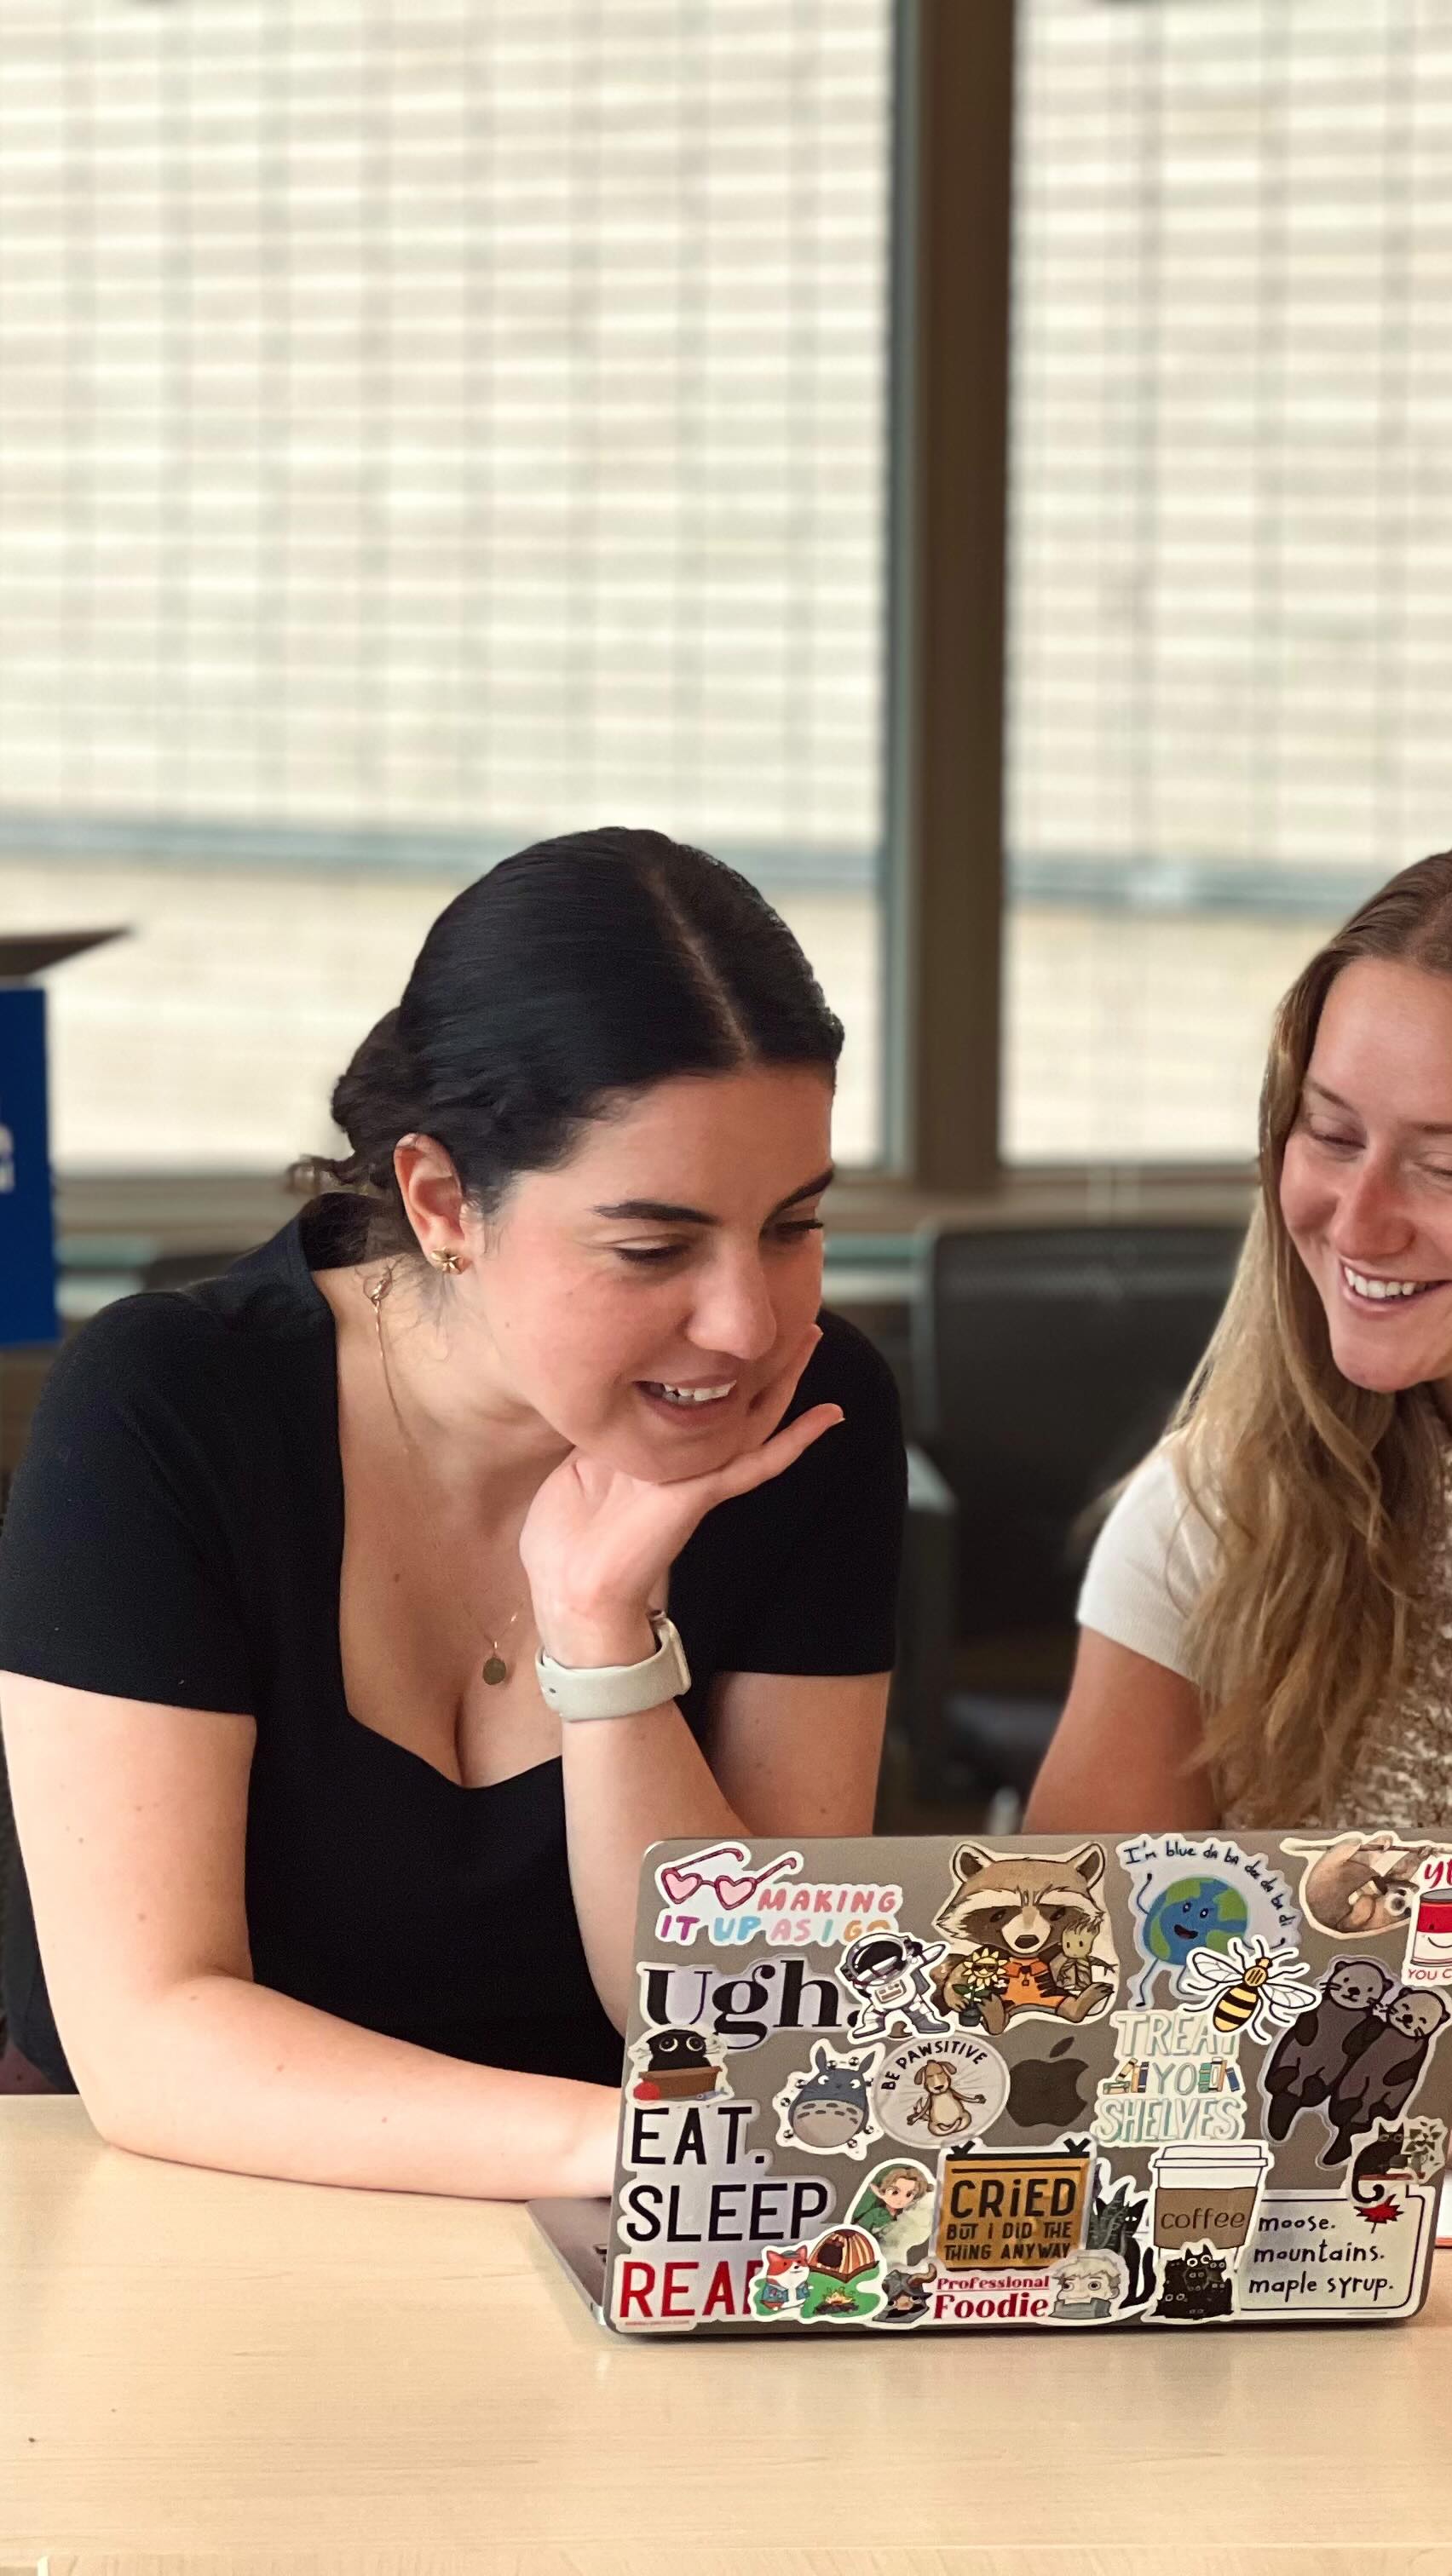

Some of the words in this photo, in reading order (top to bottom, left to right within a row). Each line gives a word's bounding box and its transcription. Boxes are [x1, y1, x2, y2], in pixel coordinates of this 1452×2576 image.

[1123, 1840, 1156, 1864] I'm
[1166, 1840, 1196, 1857] blue
[1203, 1843, 1218, 1859] da
[1224, 1847, 1239, 1866] ba
[758, 1888, 896, 1913] MAKING
[660, 1915, 700, 1941] IT
[713, 1916, 761, 1942] UP
[771, 1918, 810, 1942] AS
[821, 1919, 833, 1943] I
[1408, 1969, 1438, 1981] YOU
[881, 2071, 900, 2090] BE
[896, 2040, 988, 2070] PAWSITIVE
[1152, 2061, 1198, 2096] YO
[1094, 2097, 1244, 2142] SHELVES
[631, 2107, 765, 2165] EAT.
[626, 2182, 829, 2242] SLEEP
[1161, 2207, 1245, 2229] coffee
[1258, 2214, 1336, 2233] moose.
[947, 2222, 978, 2240] BUT
[1043, 2221, 1073, 2239] THE
[1000, 2242, 1072, 2260] ANYWAY
[1253, 2240, 1385, 2264] mountains.
[937, 2275, 1050, 2290] Professional
[1248, 2273, 1319, 2303] maple
[1327, 2275, 1394, 2303] syrup.
[933, 2291, 1049, 2320] Foodie
